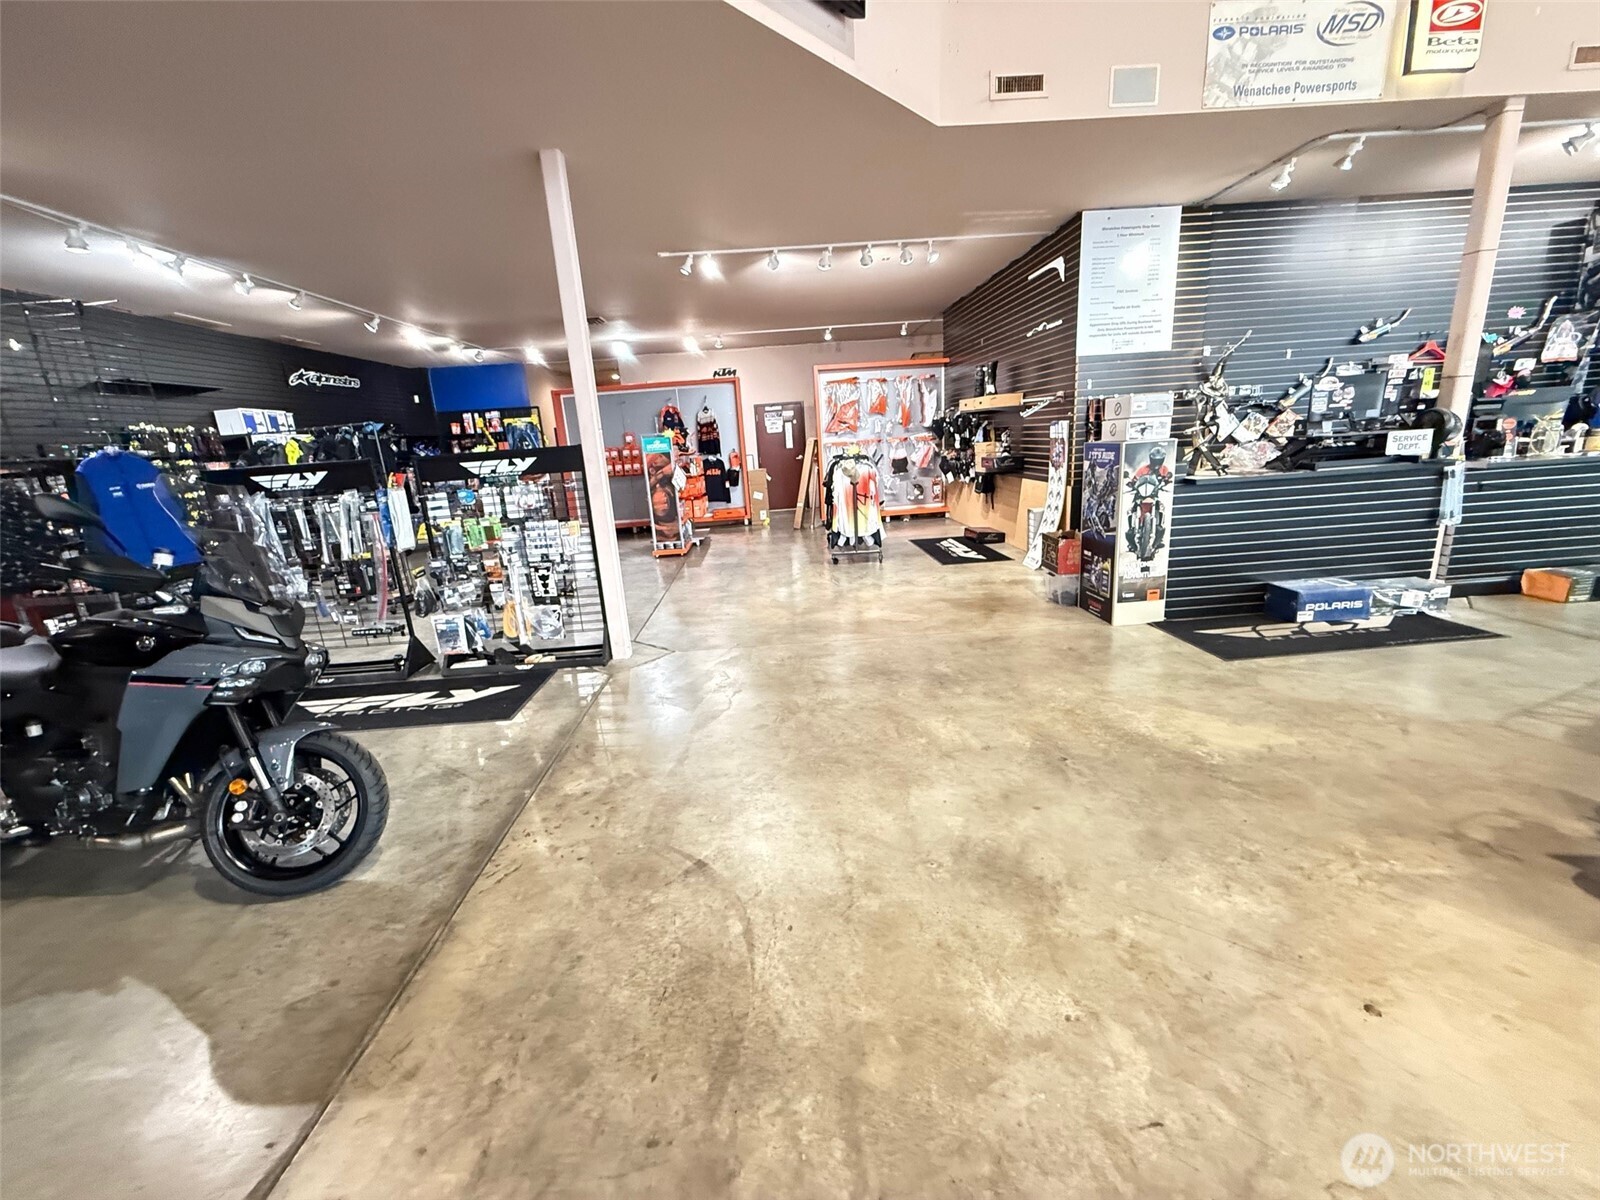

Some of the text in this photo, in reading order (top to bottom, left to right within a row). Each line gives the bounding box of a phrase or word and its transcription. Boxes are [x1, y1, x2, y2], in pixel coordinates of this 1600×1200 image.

[1239, 23, 1306, 37] POLARIS
[1322, 13, 1380, 34] MSD
[1427, 36, 1479, 46] Beta
[1309, 57, 1355, 65] OUTSTANDING
[1233, 80, 1358, 97] Wenatchee Powersports
[309, 371, 360, 388] alpinestars
[713, 367, 737, 378] KTM
[1392, 433, 1428, 443] SERVICE
[1397, 442, 1420, 451] DEPT.
[458, 456, 538, 475] FLY
[249, 470, 329, 489] FLY
[1305, 599, 1363, 611] POLARIS
[314, 703, 464, 718] RACING
